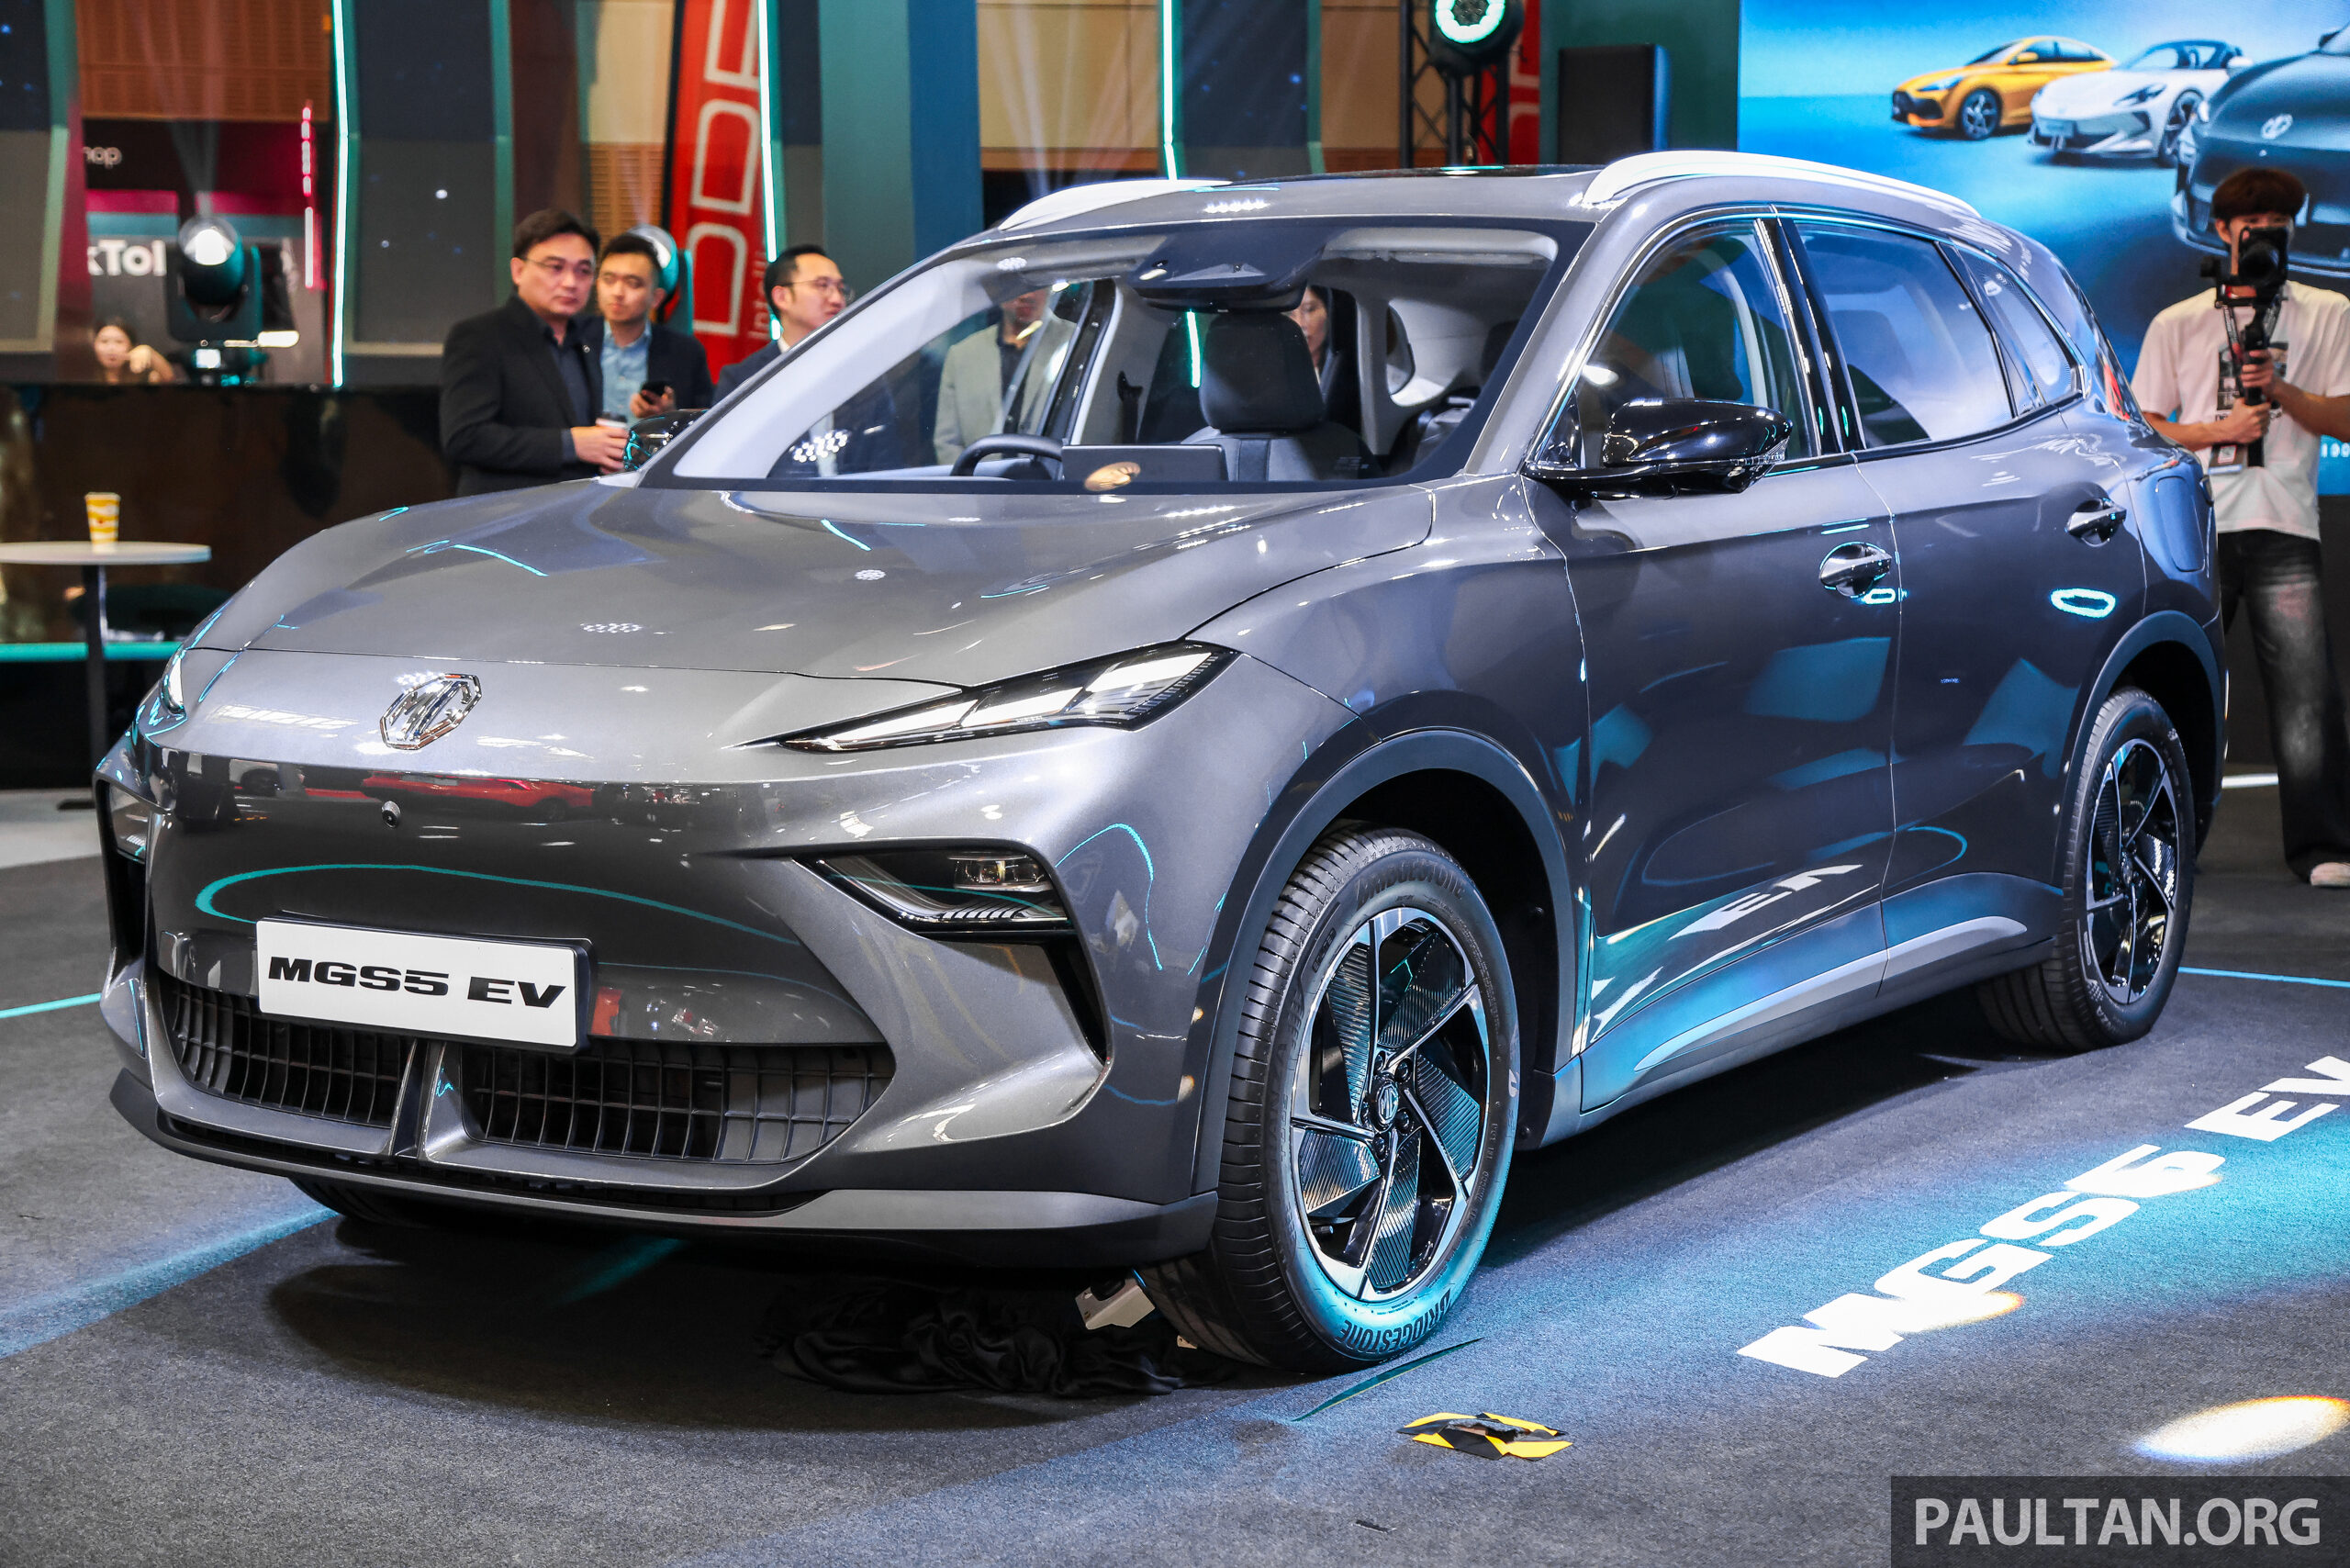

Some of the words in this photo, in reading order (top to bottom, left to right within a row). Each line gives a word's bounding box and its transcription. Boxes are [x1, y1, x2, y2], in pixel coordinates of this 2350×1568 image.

[268, 957, 449, 996] MGS5
[467, 976, 566, 1008] EV
[1335, 1288, 1451, 1354] BRIDGESTONE
